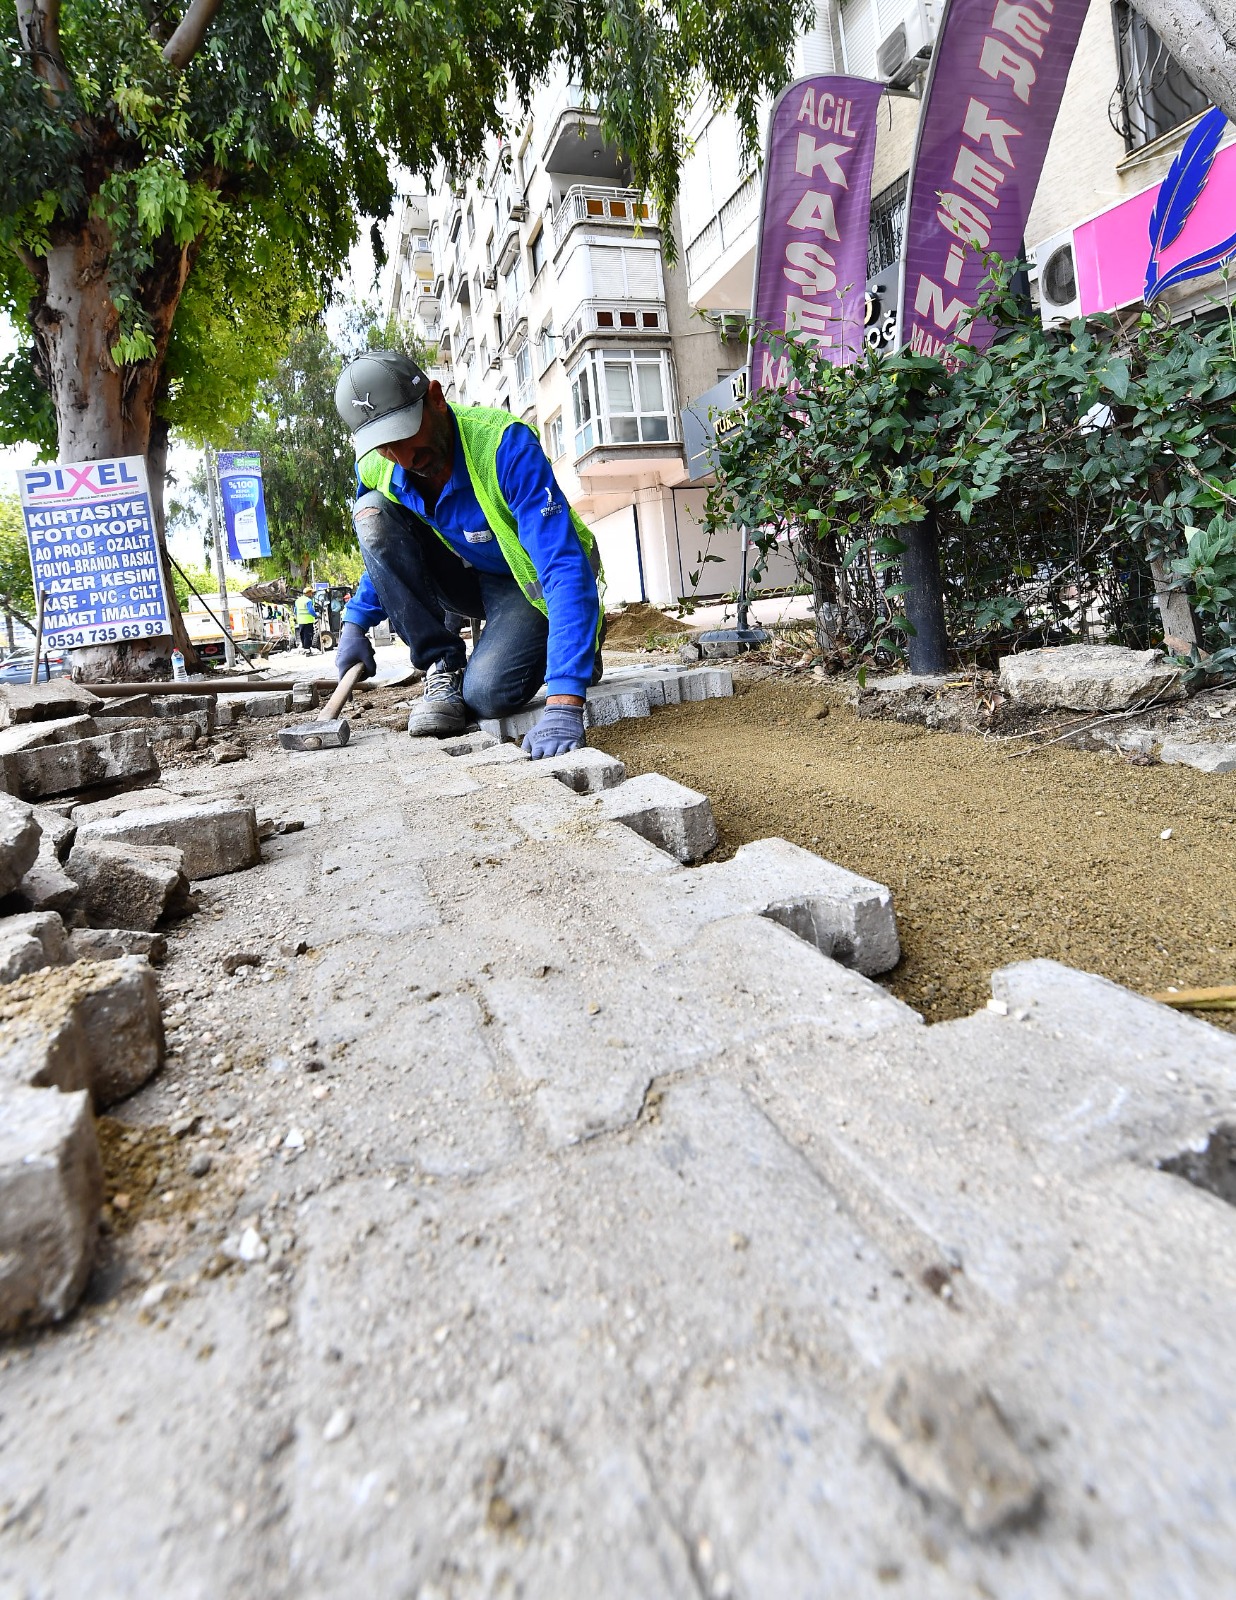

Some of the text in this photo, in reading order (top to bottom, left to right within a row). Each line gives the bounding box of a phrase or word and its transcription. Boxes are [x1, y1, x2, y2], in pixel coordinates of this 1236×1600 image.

[782, 131, 853, 348] KAŞE
[25, 462, 139, 497] PIXEL
[54, 541, 97, 559] PROJE
[36, 550, 155, 579] FOLYO-BRANDA BASKI
[38, 575, 96, 595] LAZER
[43, 595, 79, 614] KAŞE
[89, 590, 118, 606] PVC
[44, 610, 97, 630] MAKET
[47, 621, 164, 648] 0534 735 63 93
